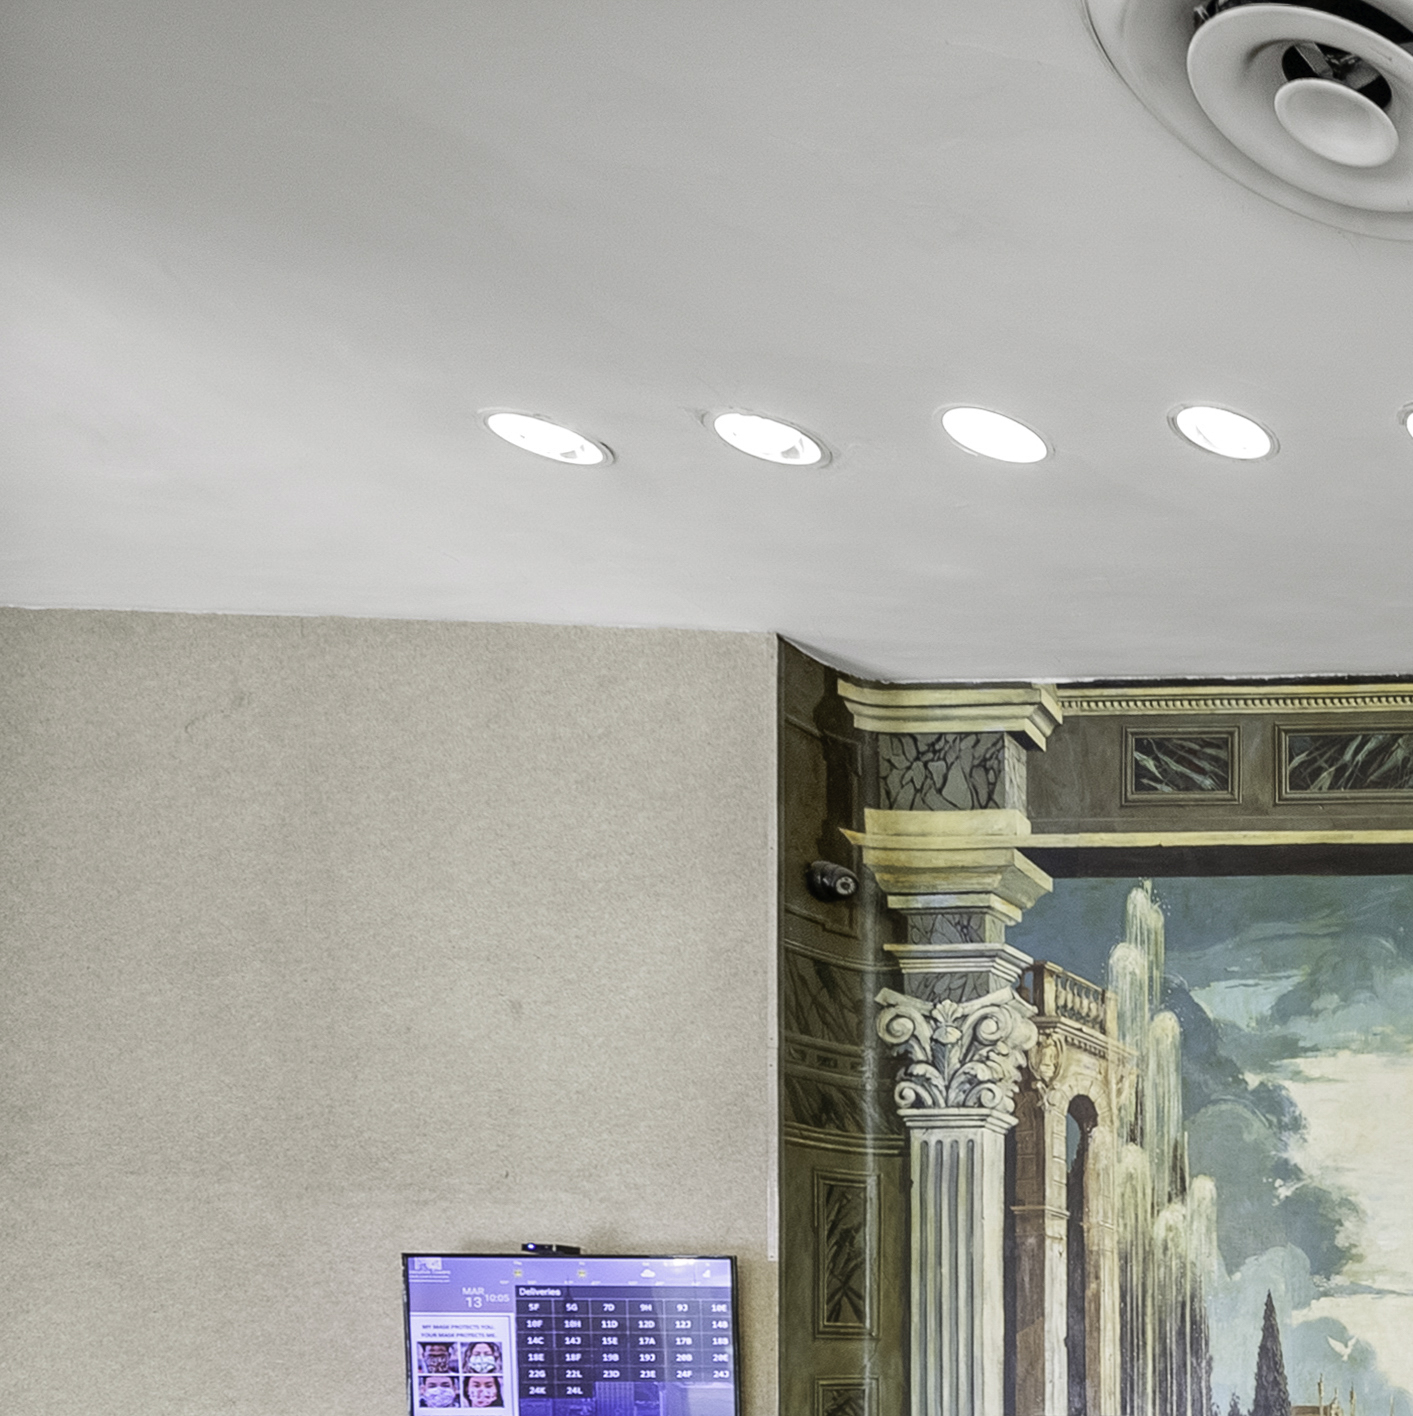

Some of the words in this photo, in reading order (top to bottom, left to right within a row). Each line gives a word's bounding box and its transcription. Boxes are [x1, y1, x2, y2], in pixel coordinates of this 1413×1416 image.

[462, 1287, 485, 1296] MAR
[485, 1293, 510, 1303] 10:05
[519, 1287, 561, 1297] Deliveries
[465, 1296, 483, 1309] 13
